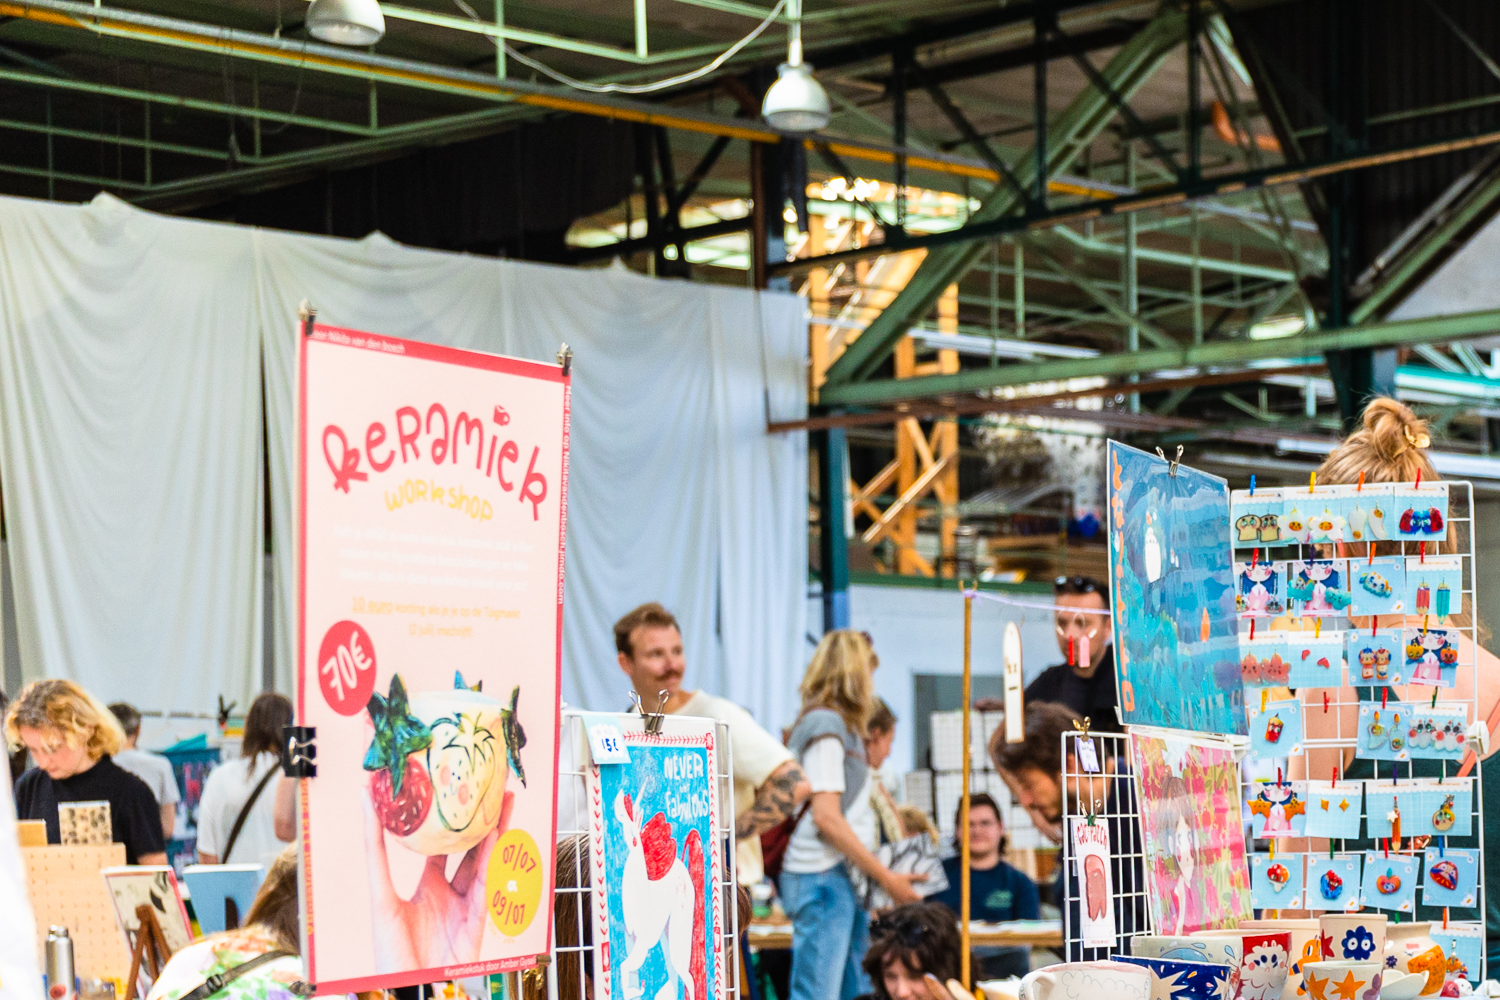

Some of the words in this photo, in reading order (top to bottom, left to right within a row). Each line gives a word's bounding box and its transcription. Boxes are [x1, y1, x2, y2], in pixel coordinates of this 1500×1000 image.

[563, 385, 573, 410] Meer
[562, 413, 572, 432] info
[561, 435, 571, 450] op
[321, 630, 373, 702] 70€
[663, 753, 704, 781] NEVER
[502, 843, 537, 873] 07/07
